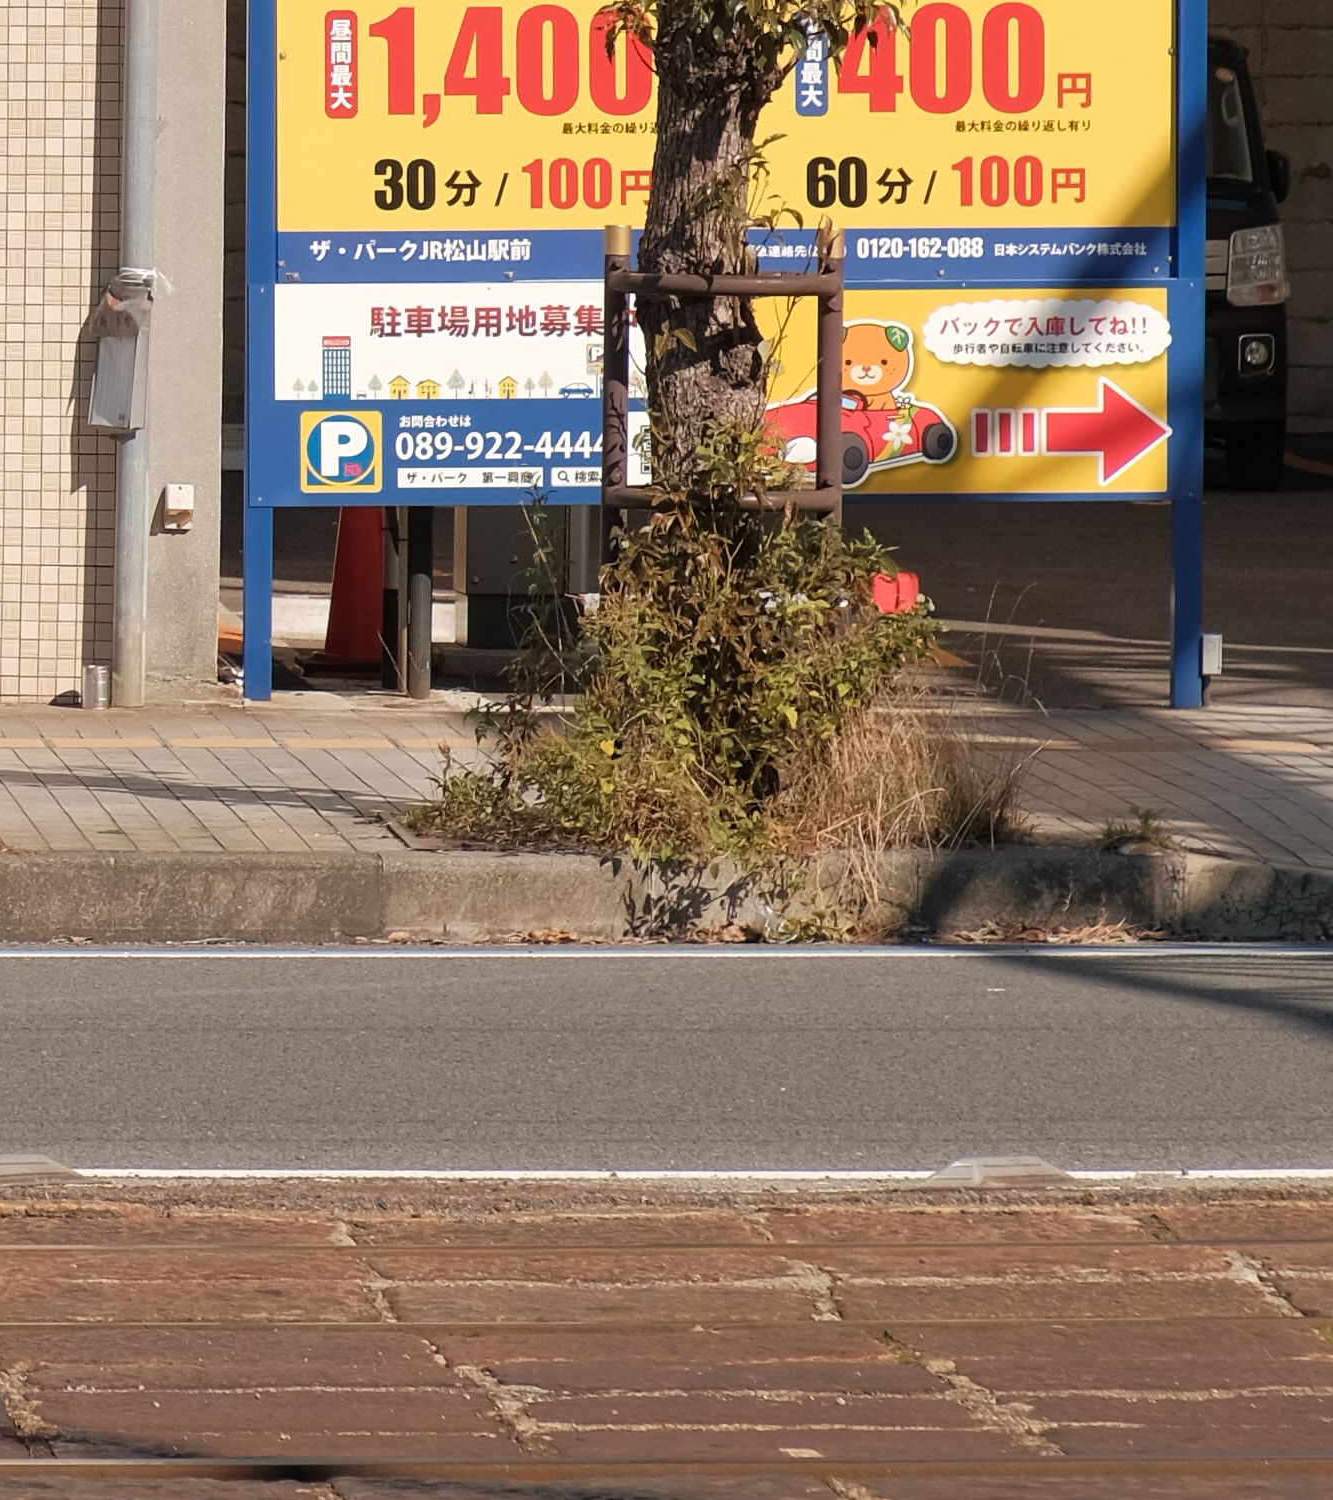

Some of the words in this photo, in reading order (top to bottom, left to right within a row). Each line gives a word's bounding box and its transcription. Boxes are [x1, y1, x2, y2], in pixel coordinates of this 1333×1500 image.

[330, 18, 353, 110] 昼間最大
[369, 3, 653, 128] 1,400
[955, 120, 1092, 133] 最大料金の繰り返し有り
[310, 239, 531, 262] ザ・パークJR松山駅前
[856, 237, 984, 259] 0120-162-088
[994, 241, 1147, 257] 日本システムバンク株式会社
[370, 304, 637, 338] 駐車場用地募集
[939, 316, 1148, 337] バックで入庫してね!!
[399, 415, 471, 428] お問合わせは
[321, 421, 368, 476] P
